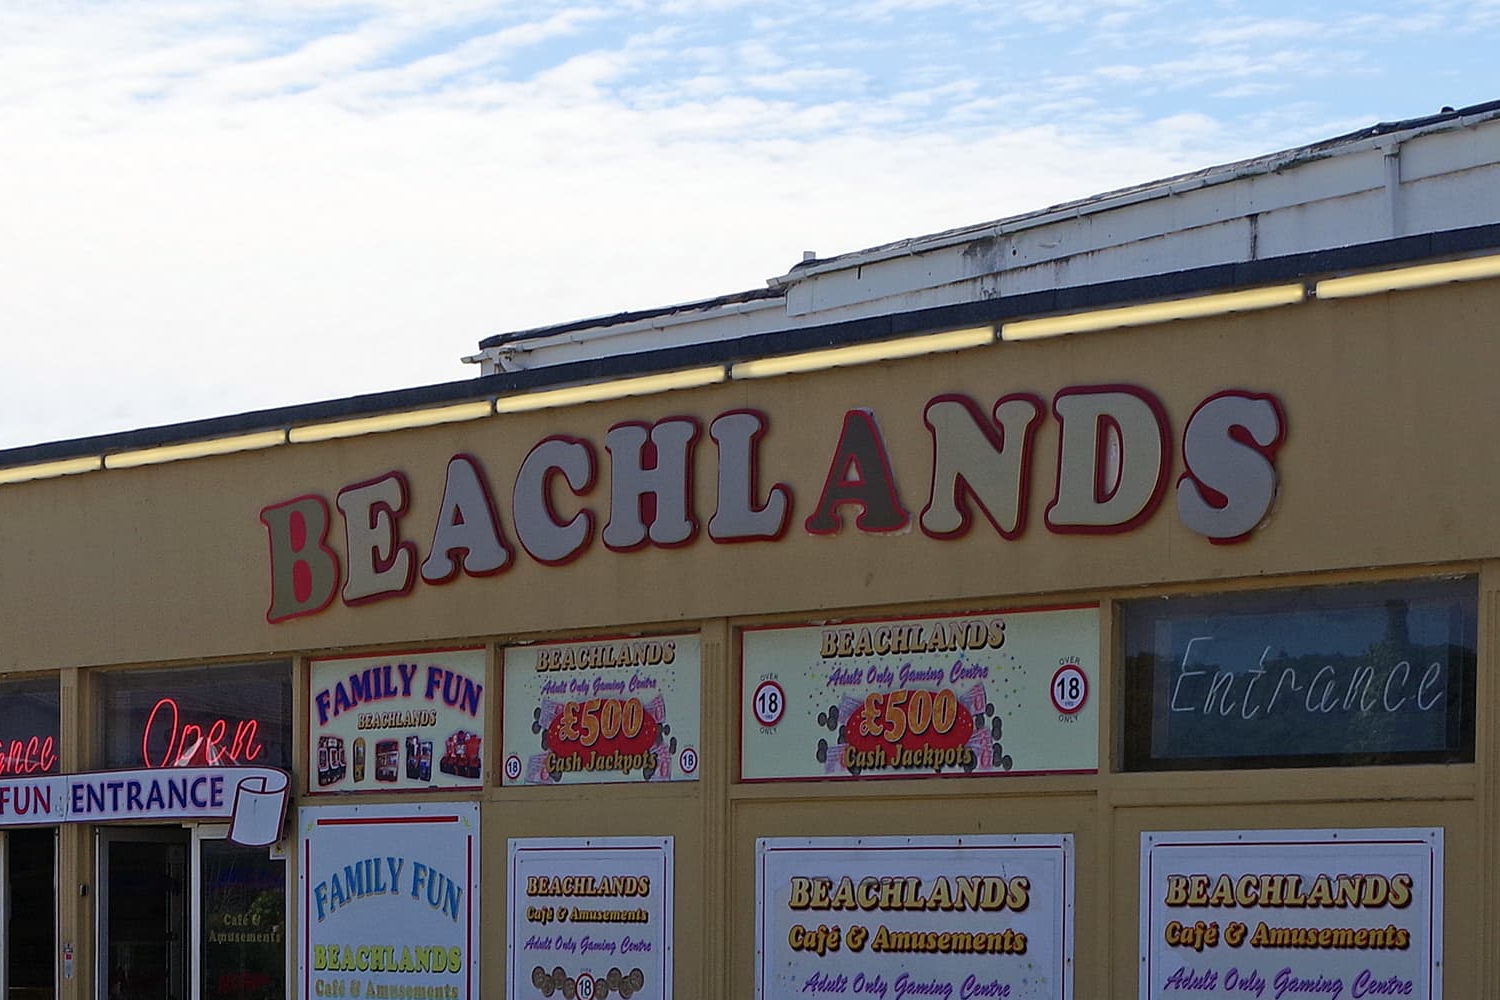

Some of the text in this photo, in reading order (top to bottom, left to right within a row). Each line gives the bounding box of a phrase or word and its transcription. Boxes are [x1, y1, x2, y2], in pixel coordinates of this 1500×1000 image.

[261, 385, 1288, 624] BEACHLANDS
[820, 618, 1006, 659] BEACHLANDS
[536, 640, 676, 672] BEACHLANDS
[827, 659, 989, 687] Adult Only Gaming Centre
[1057, 677, 1079, 700] 18
[1169, 637, 1445, 720] Entrance
[315, 664, 483, 726] FAMILY FUN
[758, 692, 778, 714] 18
[357, 709, 437, 730] BEACHLANDS
[558, 697, 644, 747] £500
[860, 687, 959, 743] £500
[142, 698, 263, 769] Open
[546, 748, 658, 775] Cash Jackpots
[845, 742, 974, 772] Cash Jackpots
[0, 785, 51, 816] FUN
[72, 776, 224, 814] ENTRANCE
[314, 857, 463, 923] FAMILY FUN
[527, 875, 651, 897] BEACHLANDS
[788, 876, 1031, 912] BEACHLANDS
[1165, 873, 1414, 908] BEACHLANDS
[223, 912, 250, 926] Café
[208, 930, 282, 943] Amusements
[788, 924, 1028, 957] Café & Amusements
[314, 944, 462, 973] BEACHLANDS
[579, 980, 592, 996] 18
[801, 971, 848, 994] Adult
[852, 971, 888, 999] Only
[959, 973, 1011, 1000] Centre
